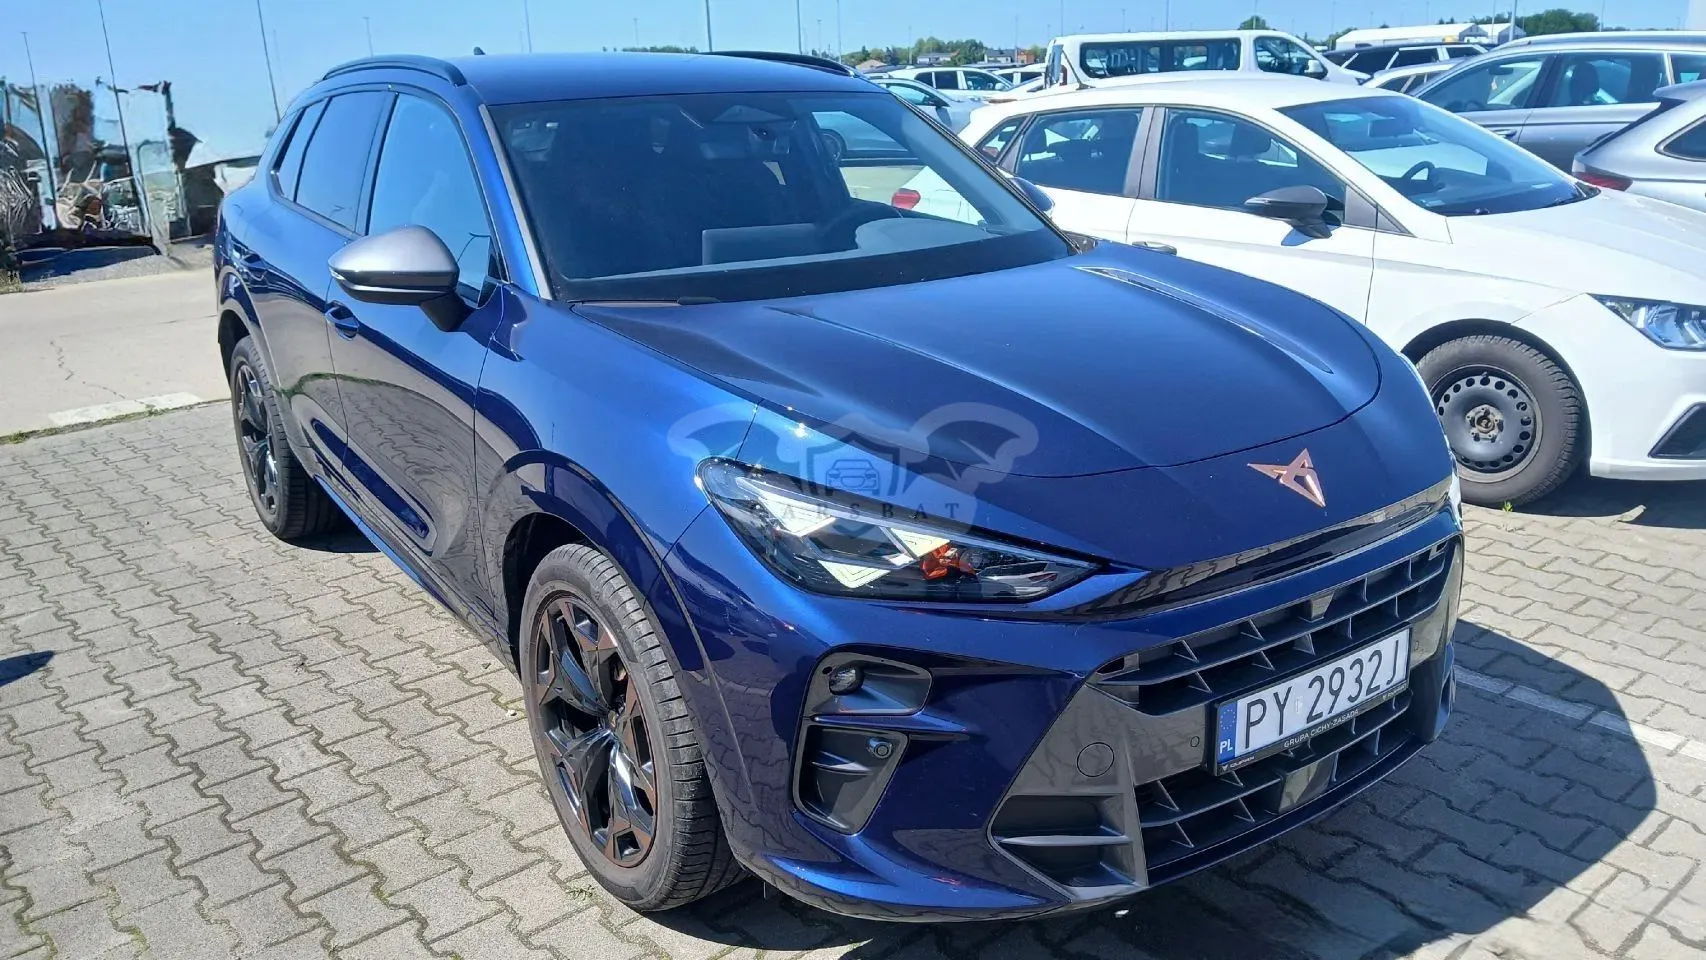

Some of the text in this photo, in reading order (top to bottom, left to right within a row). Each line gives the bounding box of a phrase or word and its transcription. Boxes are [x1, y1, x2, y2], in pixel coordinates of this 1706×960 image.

[1245, 639, 1400, 750] PY 2932J
[1219, 739, 1233, 754] PL
[1283, 732, 1310, 748] GRUPA
